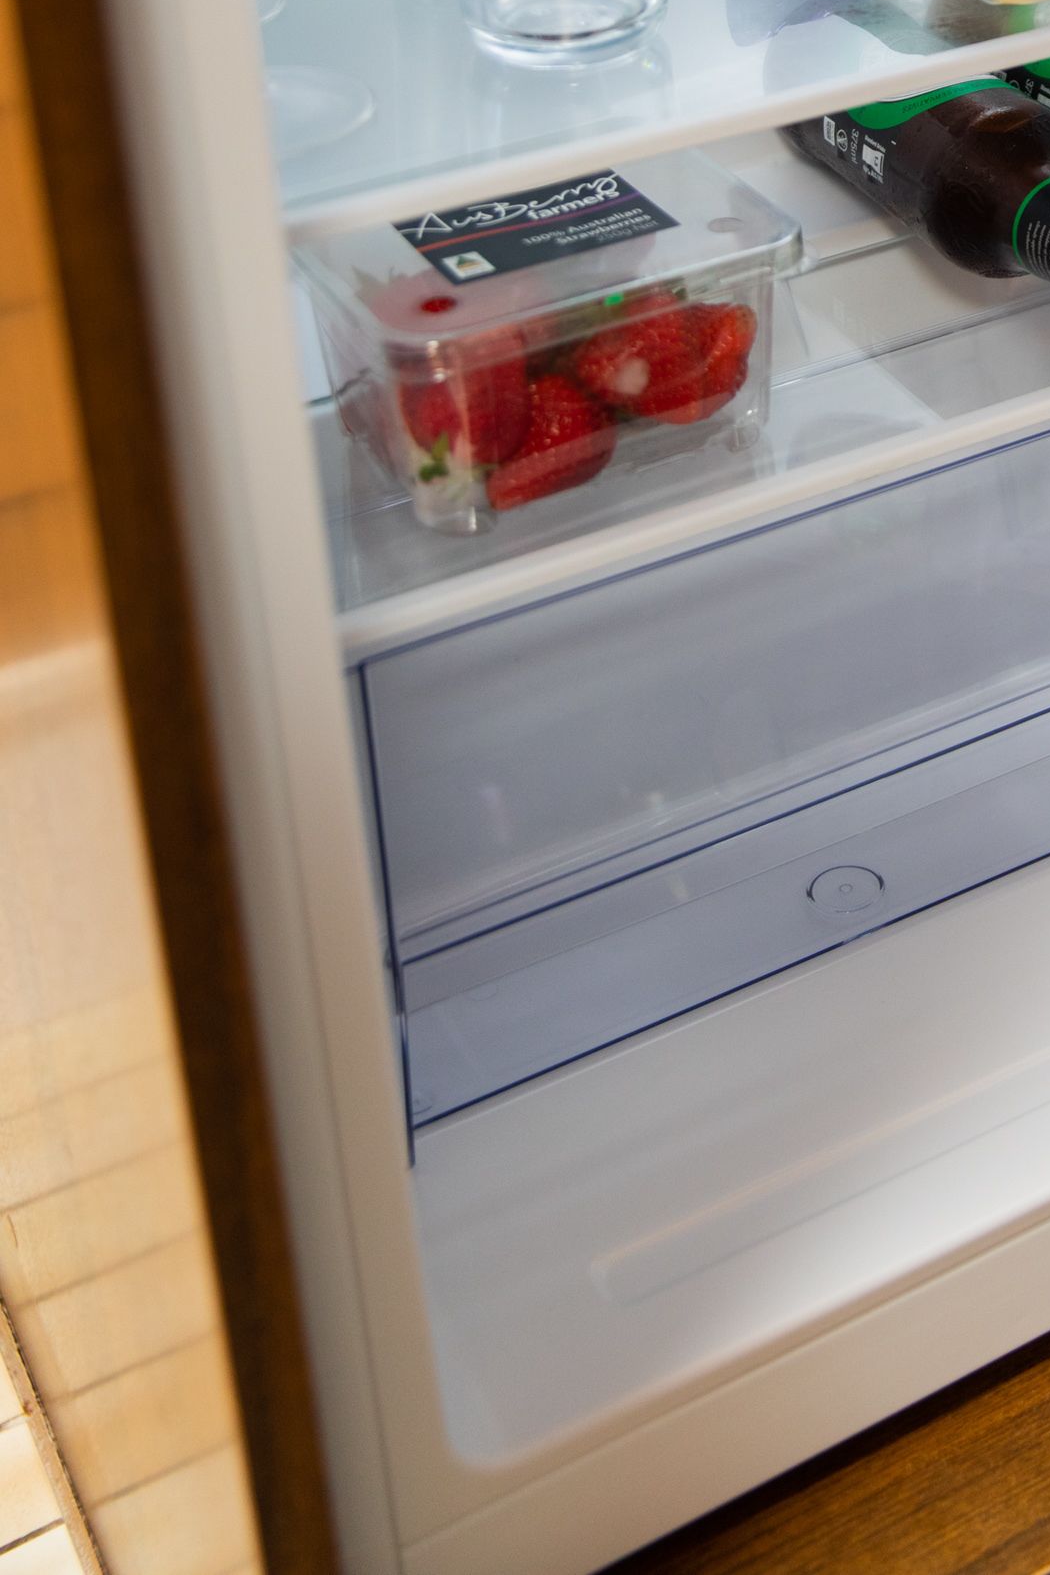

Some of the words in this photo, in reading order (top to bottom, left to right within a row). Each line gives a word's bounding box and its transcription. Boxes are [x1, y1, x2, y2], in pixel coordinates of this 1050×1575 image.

[399, 173, 618, 240] AusBerry
[527, 189, 620, 220] farmers
[521, 229, 566, 245] 100%
[568, 207, 643, 234] Australian
[555, 214, 652, 245] Strawberries
